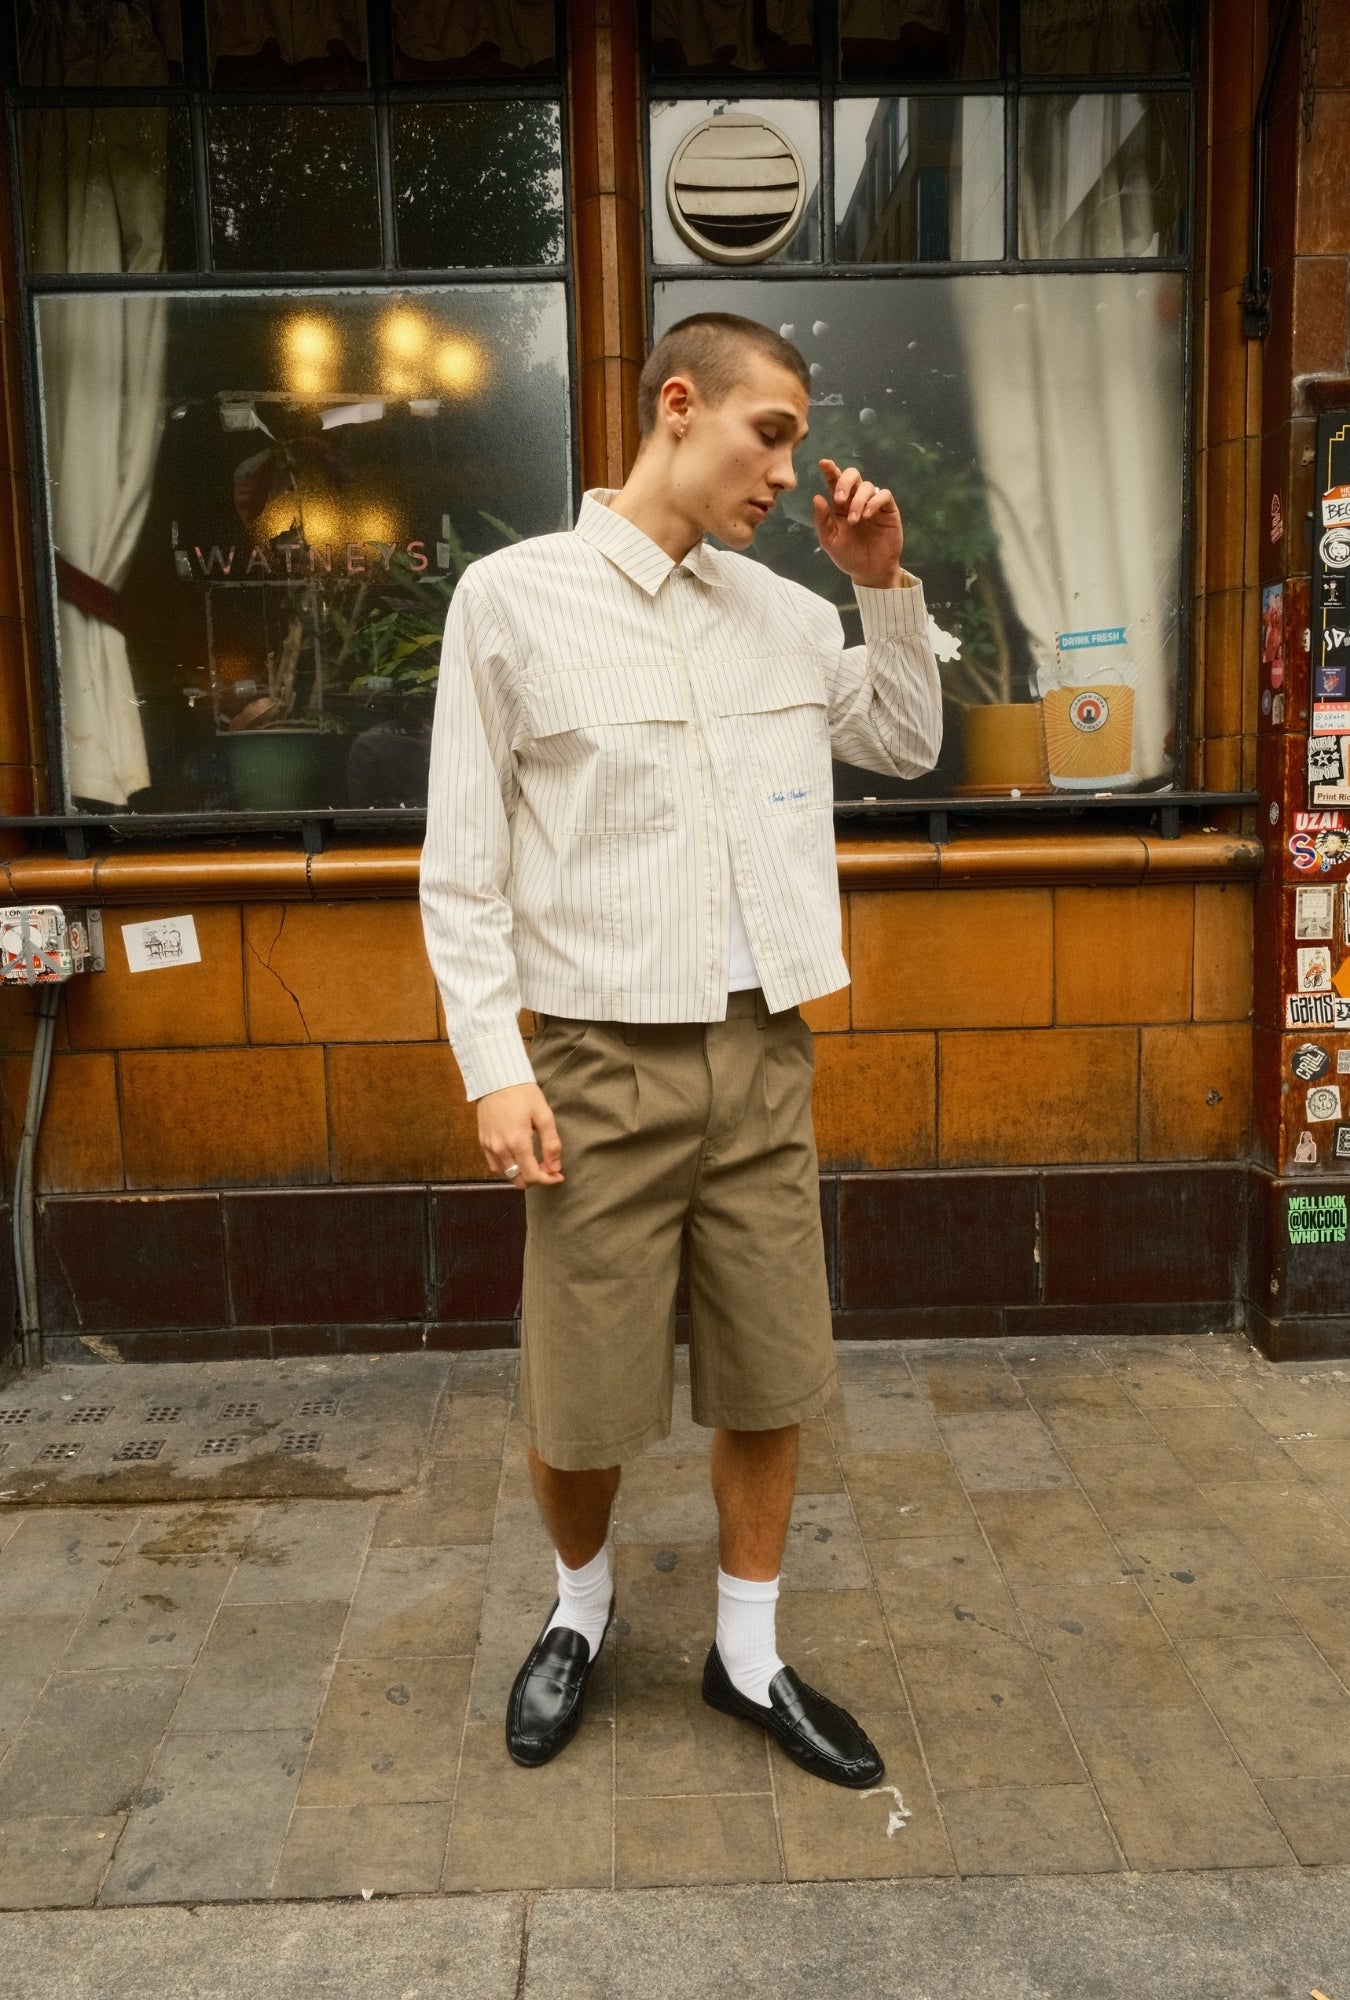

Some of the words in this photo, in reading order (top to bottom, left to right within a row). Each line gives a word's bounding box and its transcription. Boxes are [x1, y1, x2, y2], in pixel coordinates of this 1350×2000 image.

[195, 541, 429, 575] WATNEYS
[1061, 635, 1090, 647] DRINK
[1091, 632, 1120, 644] FRESH
[1317, 792, 1337, 801] Print
[1289, 1196, 1317, 1210] WELL
[1318, 1195, 1346, 1208] LOOK
[1290, 1209, 1346, 1230] @OKCOOL
[1290, 1230, 1319, 1244] WHO
[1320, 1230, 1332, 1242] IT
[1333, 1229, 1346, 1242] IS
